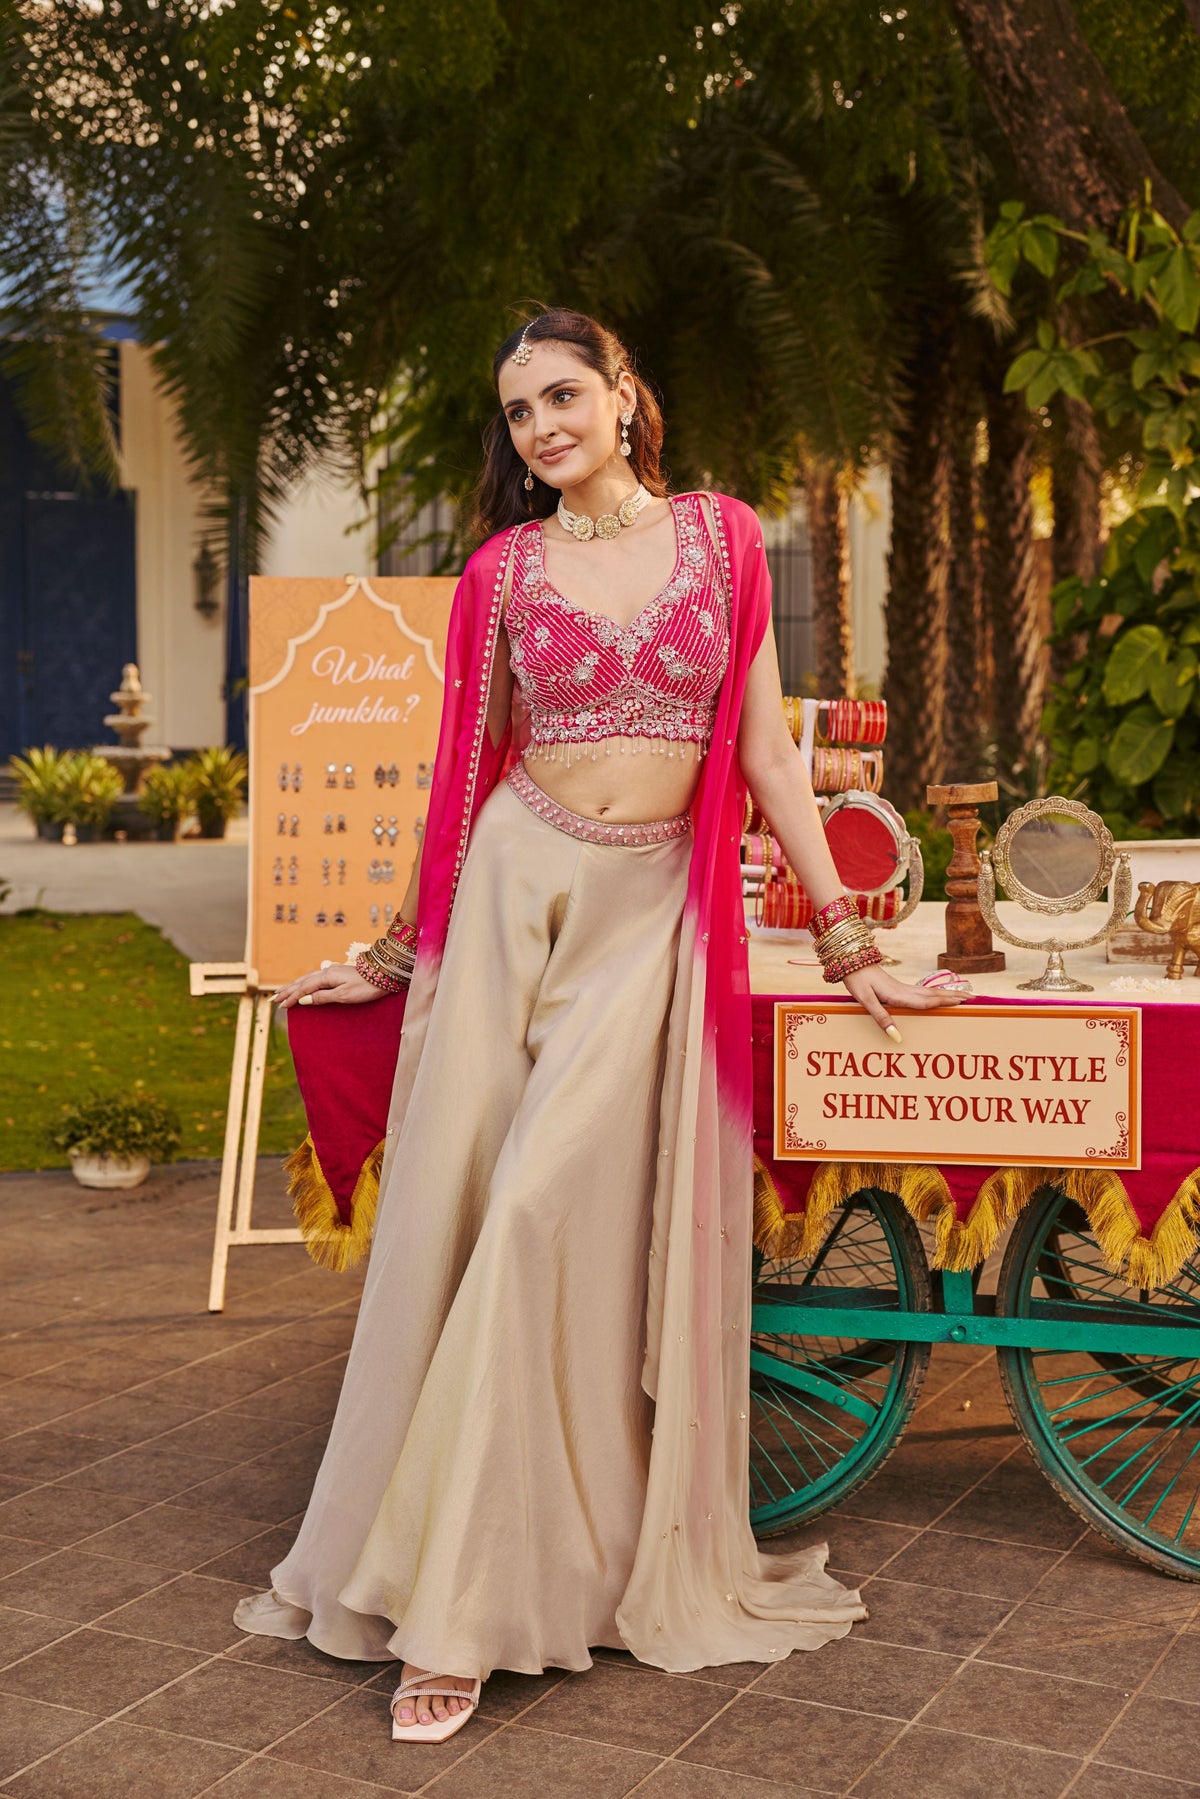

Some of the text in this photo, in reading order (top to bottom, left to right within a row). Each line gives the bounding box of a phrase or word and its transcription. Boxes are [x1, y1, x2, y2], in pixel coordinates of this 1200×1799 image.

[311, 646, 415, 685] What
[290, 694, 421, 736] jumkha?
[806, 1051, 1108, 1083] STACK YOUR STYLE
[822, 1092, 1092, 1125] SHINE YOUR WAY
